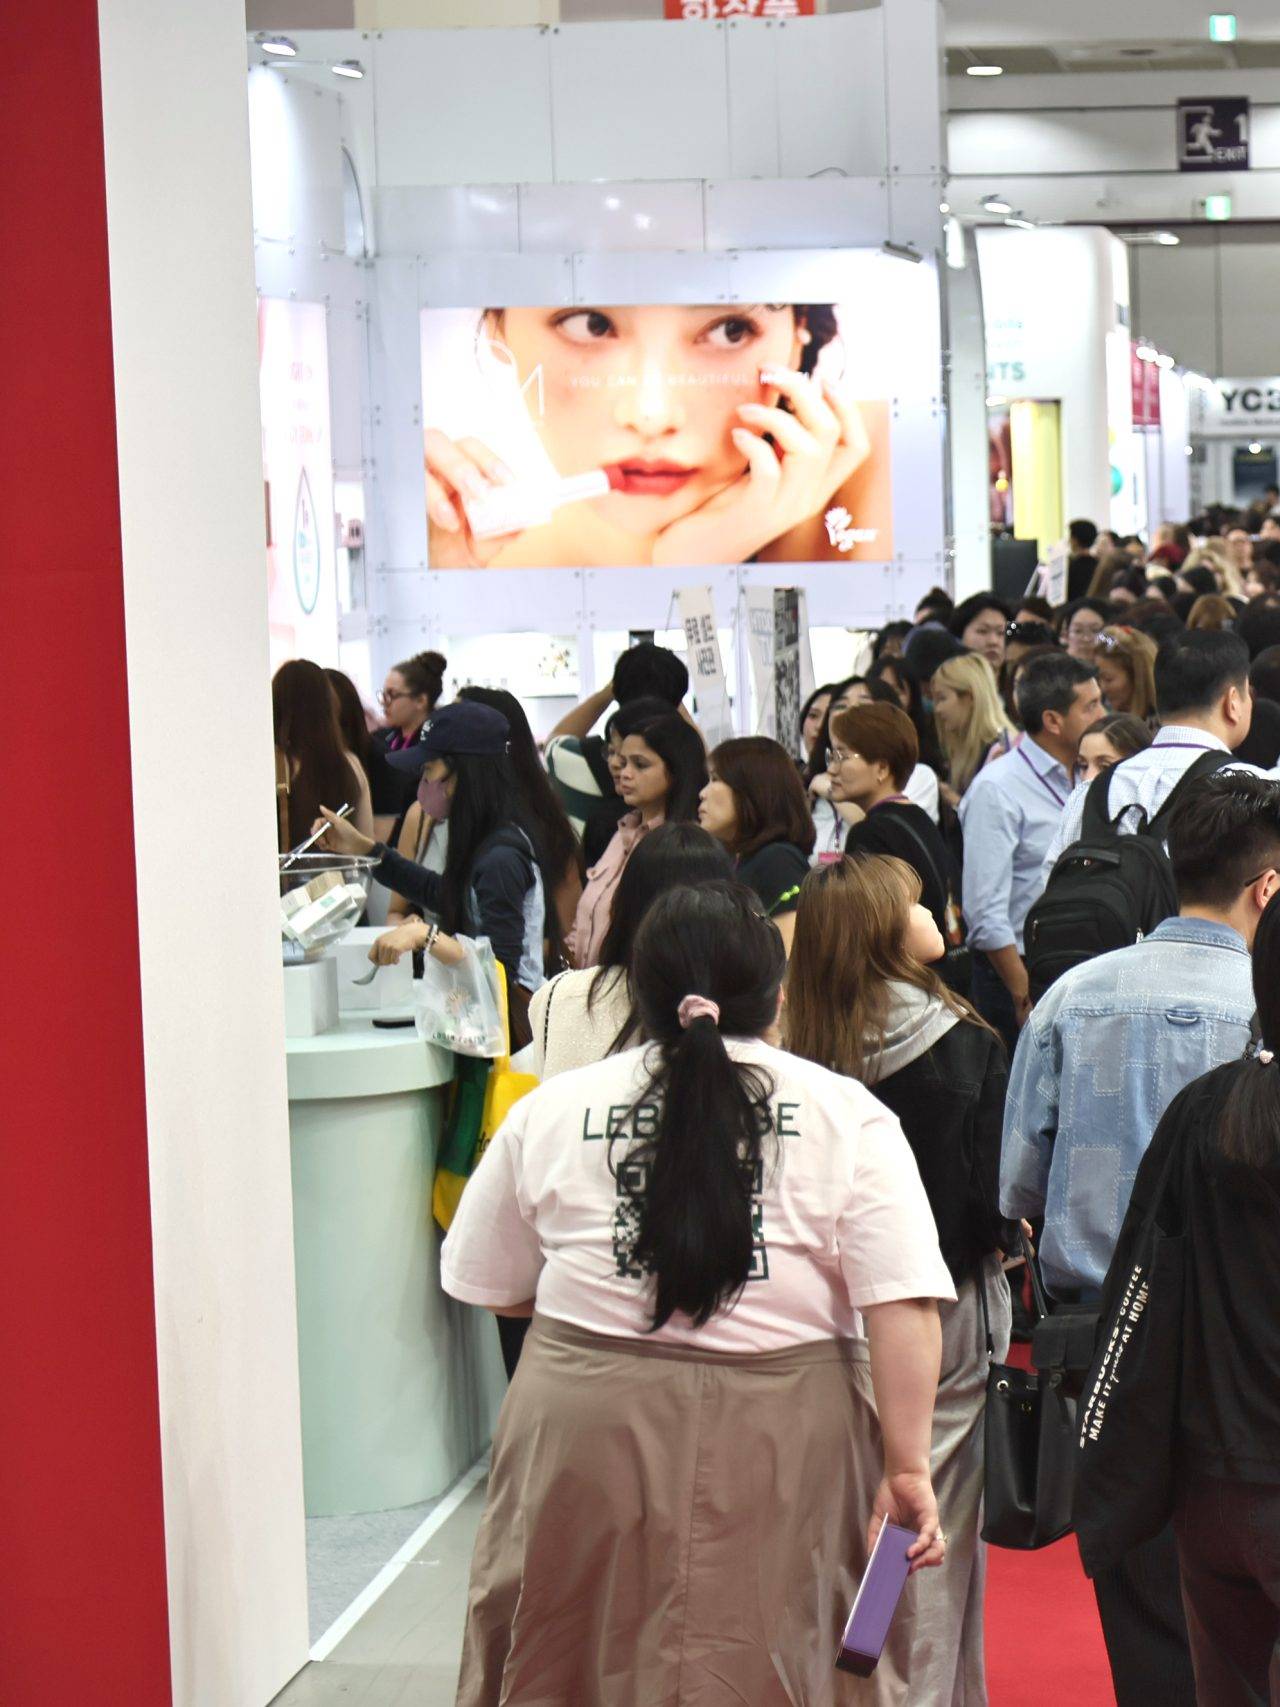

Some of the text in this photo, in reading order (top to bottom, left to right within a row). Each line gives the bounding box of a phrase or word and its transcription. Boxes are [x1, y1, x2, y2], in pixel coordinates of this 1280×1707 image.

[582, 1102, 802, 1142] LEBGE
[1088, 1399, 1108, 1442] MAKE
[1102, 1381, 1114, 1398] IT
[1121, 1324, 1134, 1344] AT
[1128, 1280, 1150, 1324] HOME
